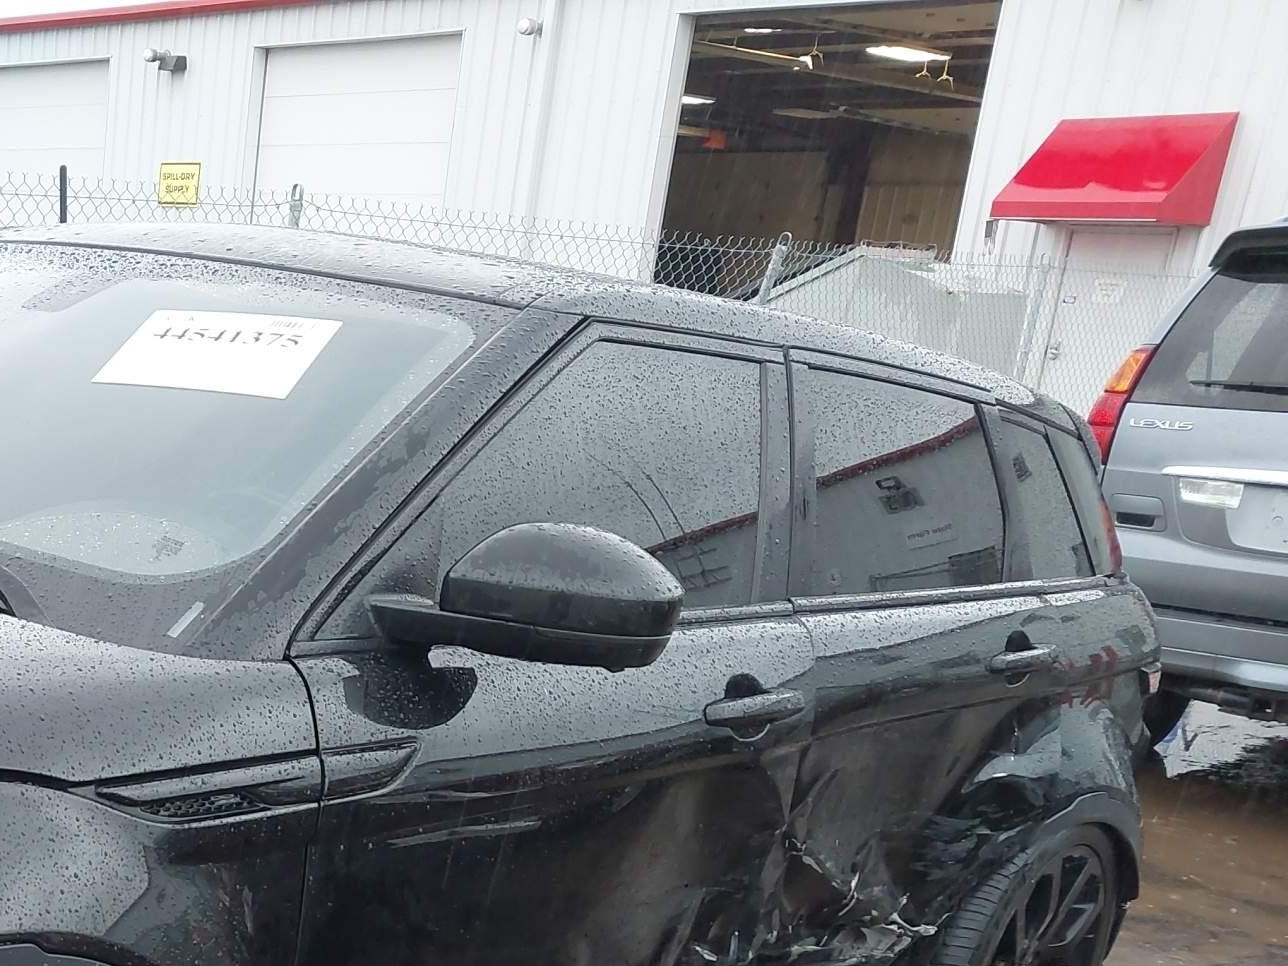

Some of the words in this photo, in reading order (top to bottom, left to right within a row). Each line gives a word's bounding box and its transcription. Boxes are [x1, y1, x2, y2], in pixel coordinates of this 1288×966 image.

[162, 172, 196, 181] SPILL-DRY
[153, 327, 303, 348] 44541375
[1129, 417, 1193, 431] LEXUS
